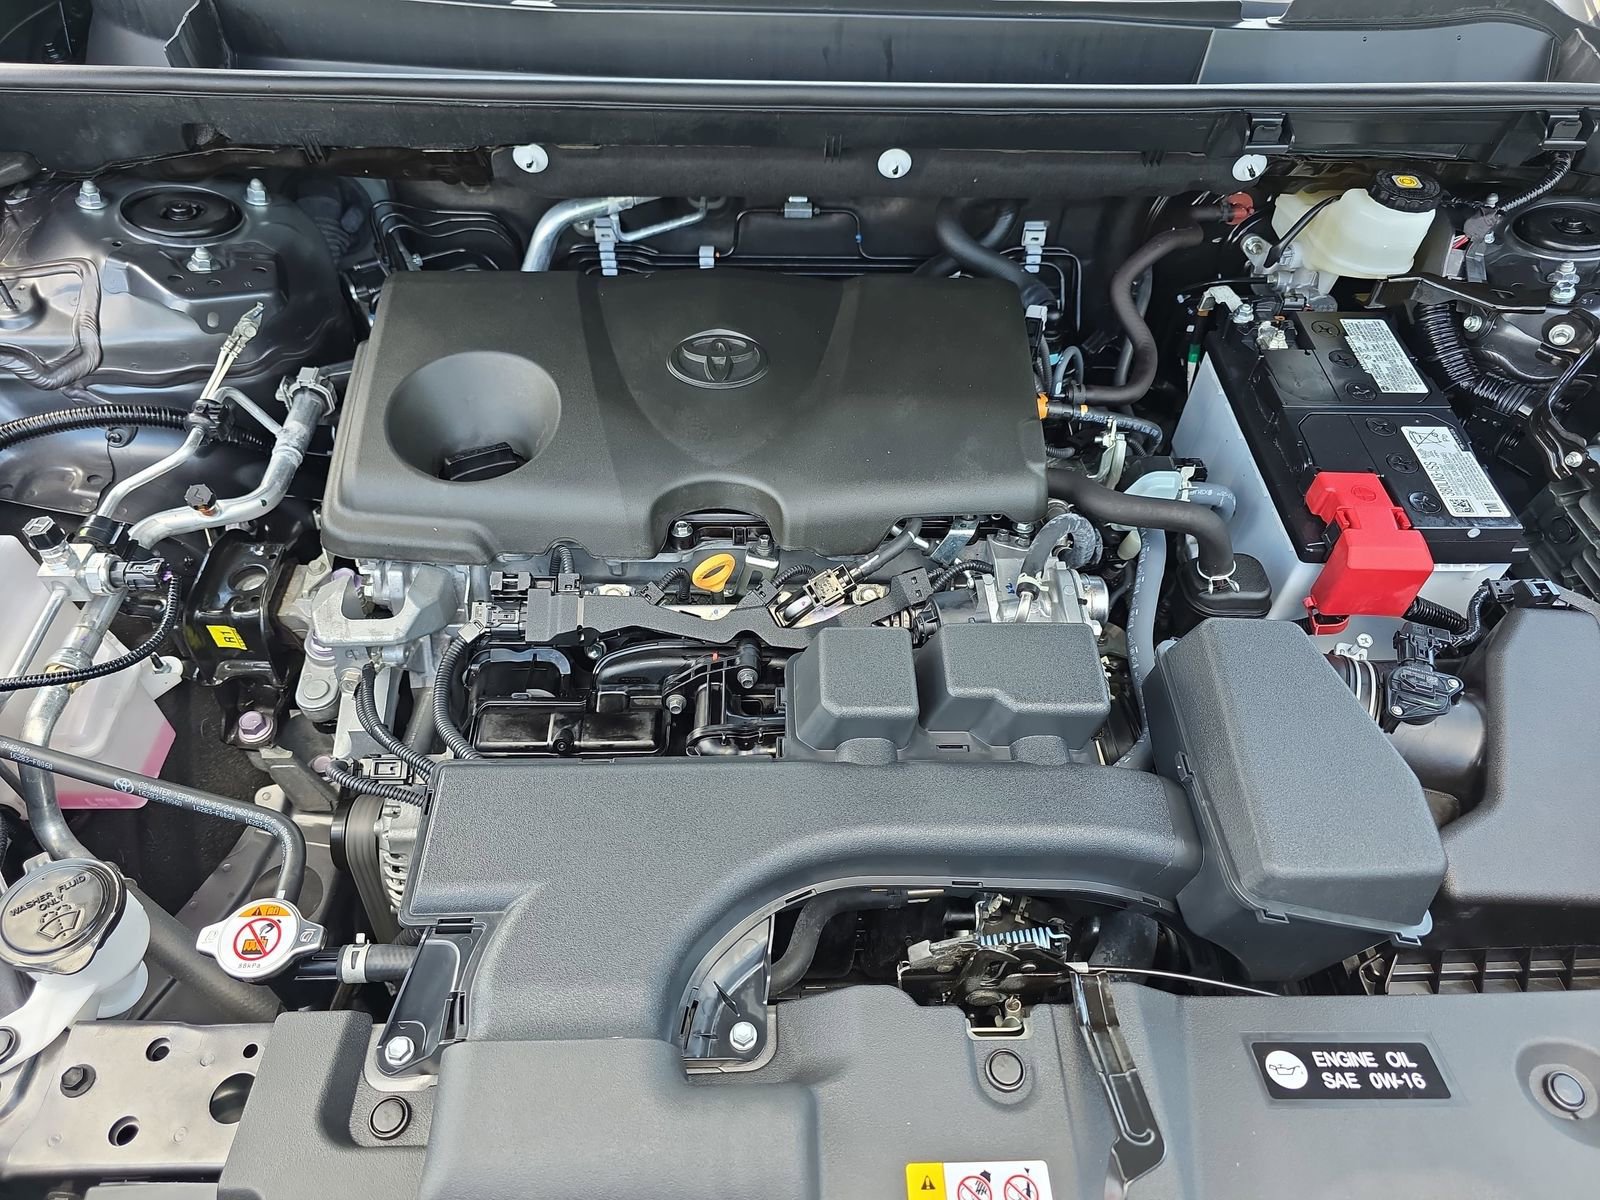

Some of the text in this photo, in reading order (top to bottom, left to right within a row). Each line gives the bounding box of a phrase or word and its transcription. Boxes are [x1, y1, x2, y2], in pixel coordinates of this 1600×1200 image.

[27, 519, 51, 533] H
[149, 784, 172, 797] WATER
[9, 875, 87, 917] WASHER FLUID
[38, 894, 64, 912] ONLY
[1311, 1051, 1418, 1068] ENGINE OIL
[1321, 1072, 1427, 1090] SAE 0W-16
